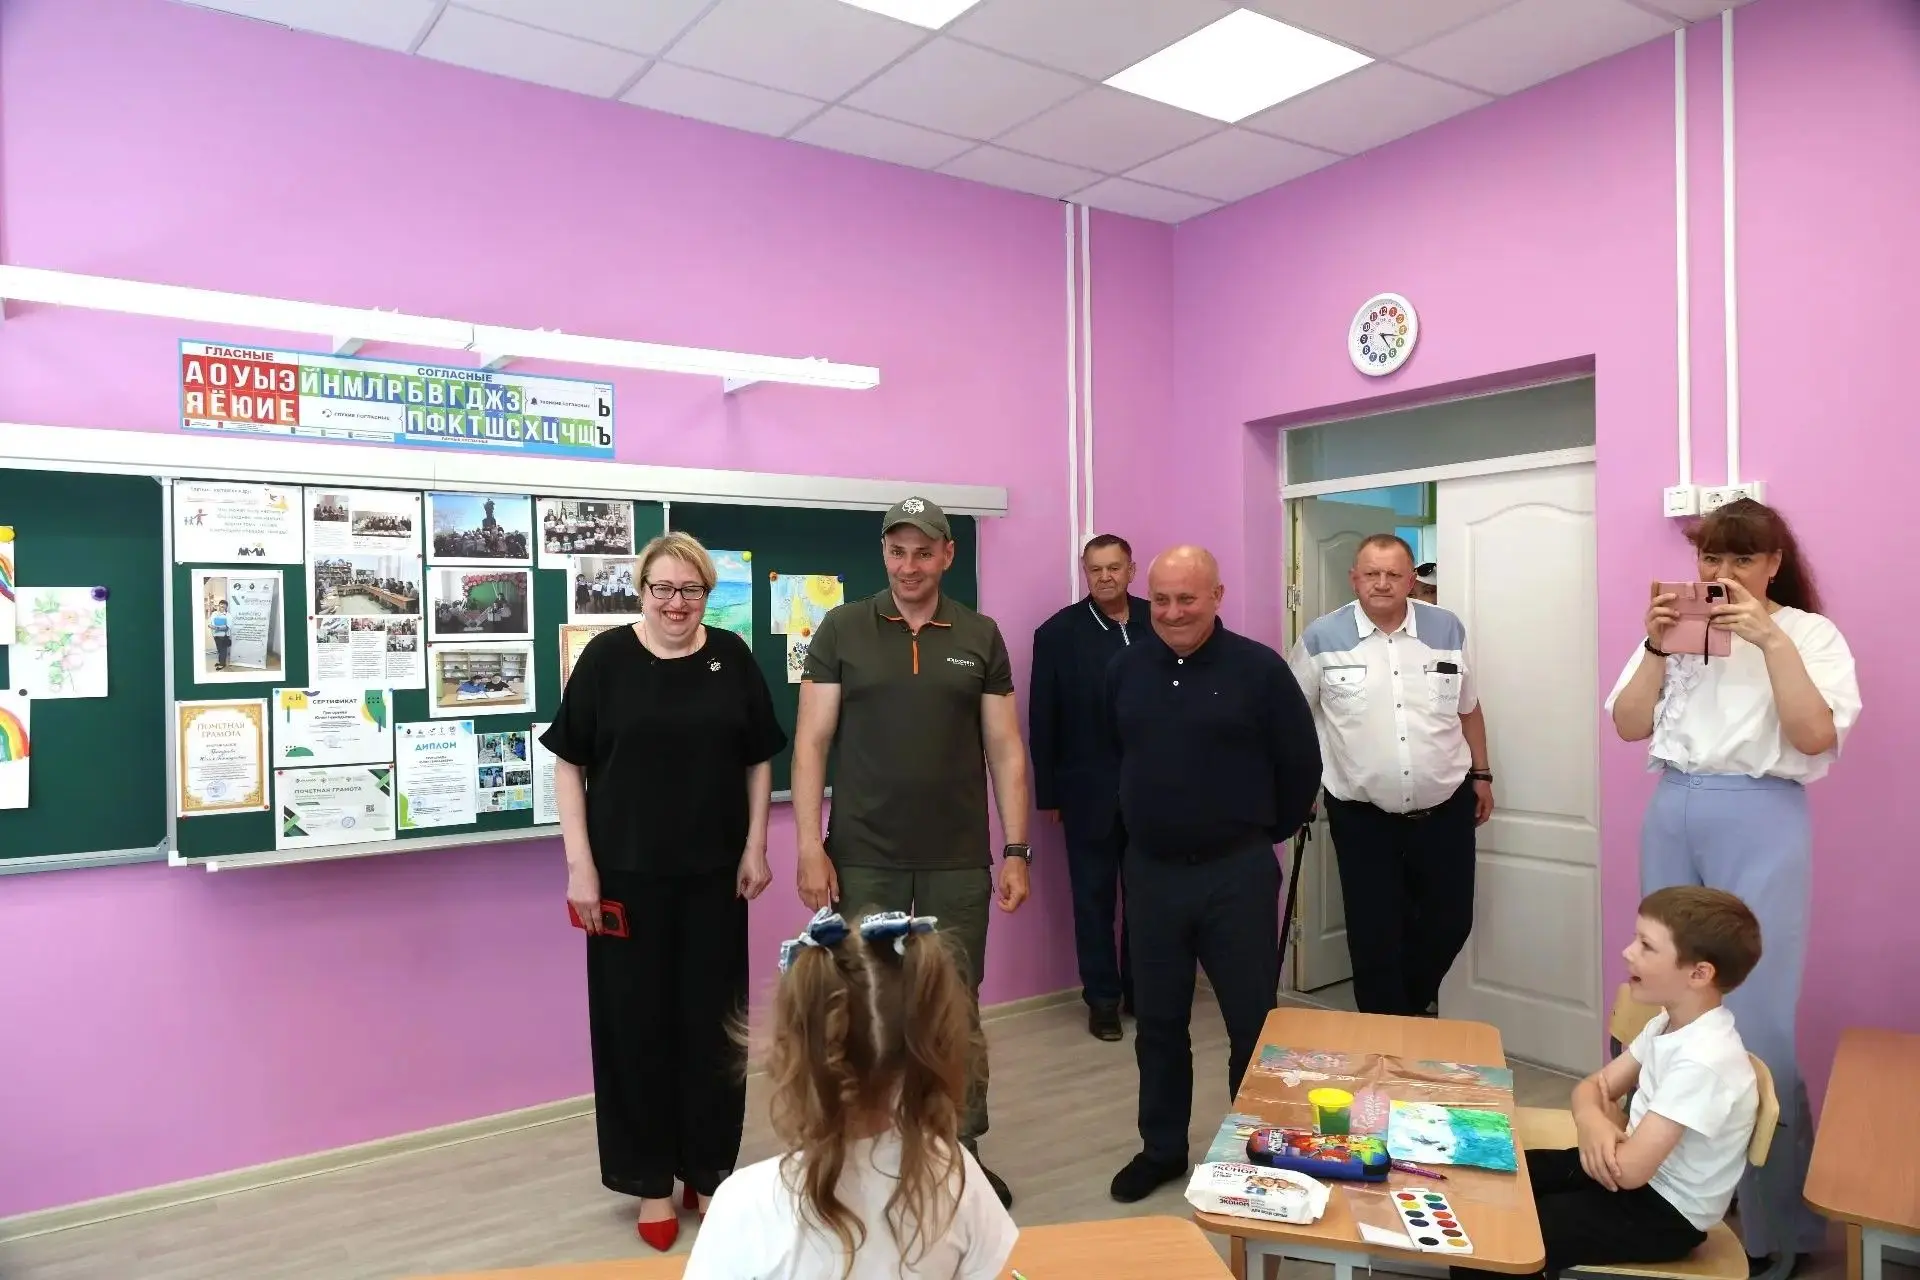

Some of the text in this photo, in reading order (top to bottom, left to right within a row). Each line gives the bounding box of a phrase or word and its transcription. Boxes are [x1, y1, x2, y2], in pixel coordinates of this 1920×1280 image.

[205, 346, 274, 361] ГЛАСНЫЕ
[417, 367, 493, 382] СОГЛАСНЫЕ
[598, 398, 611, 417] Ь
[596, 426, 612, 446] Ъ
[197, 722, 246, 732] ПОЧЕТНАЯ
[201, 730, 242, 739] ГРАМОТА
[415, 741, 457, 751] ДИПЛОМ
